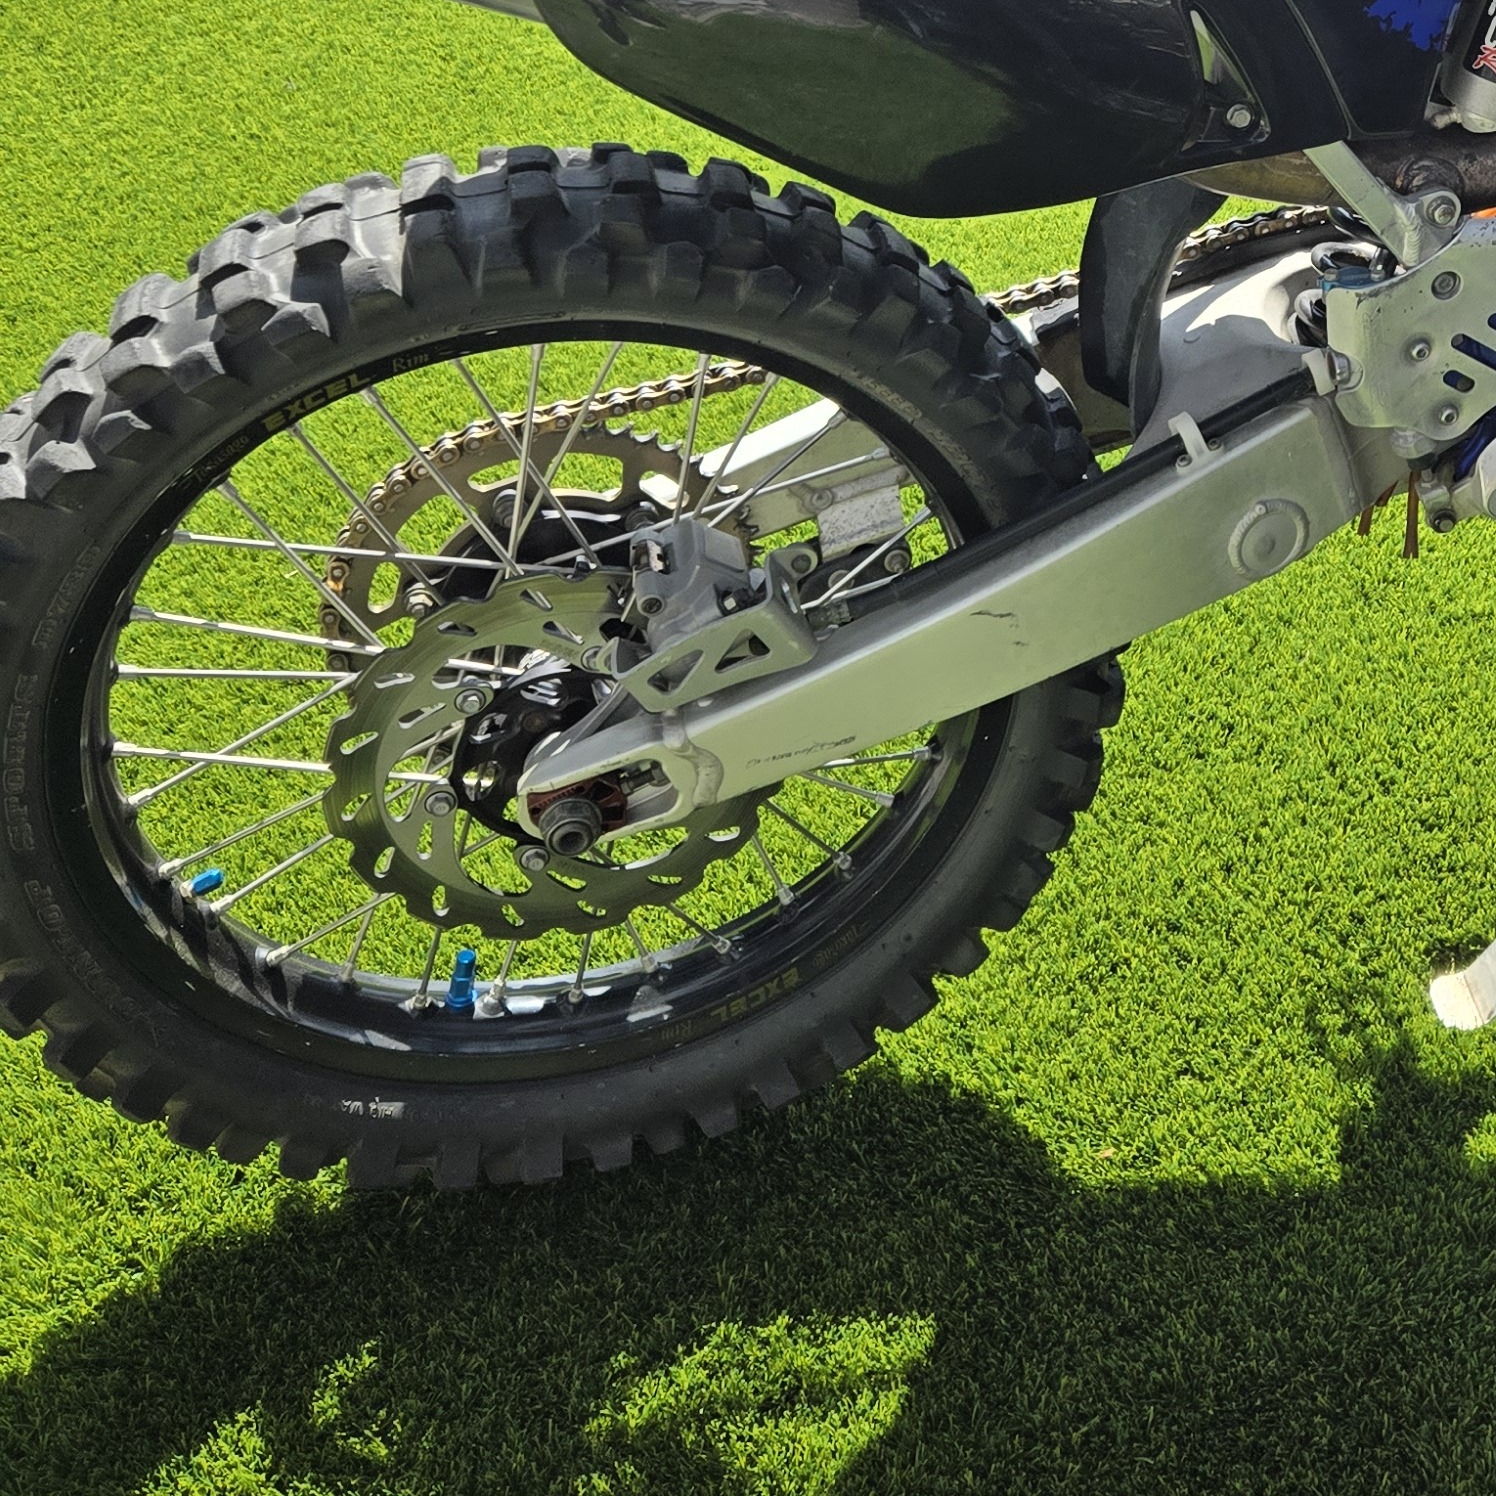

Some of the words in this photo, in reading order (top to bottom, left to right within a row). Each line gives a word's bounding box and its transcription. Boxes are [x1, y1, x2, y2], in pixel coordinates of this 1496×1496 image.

[260, 374, 375, 432] EXCEL
[392, 352, 430, 373] Rim
[710, 967, 800, 1022] EXCEL
